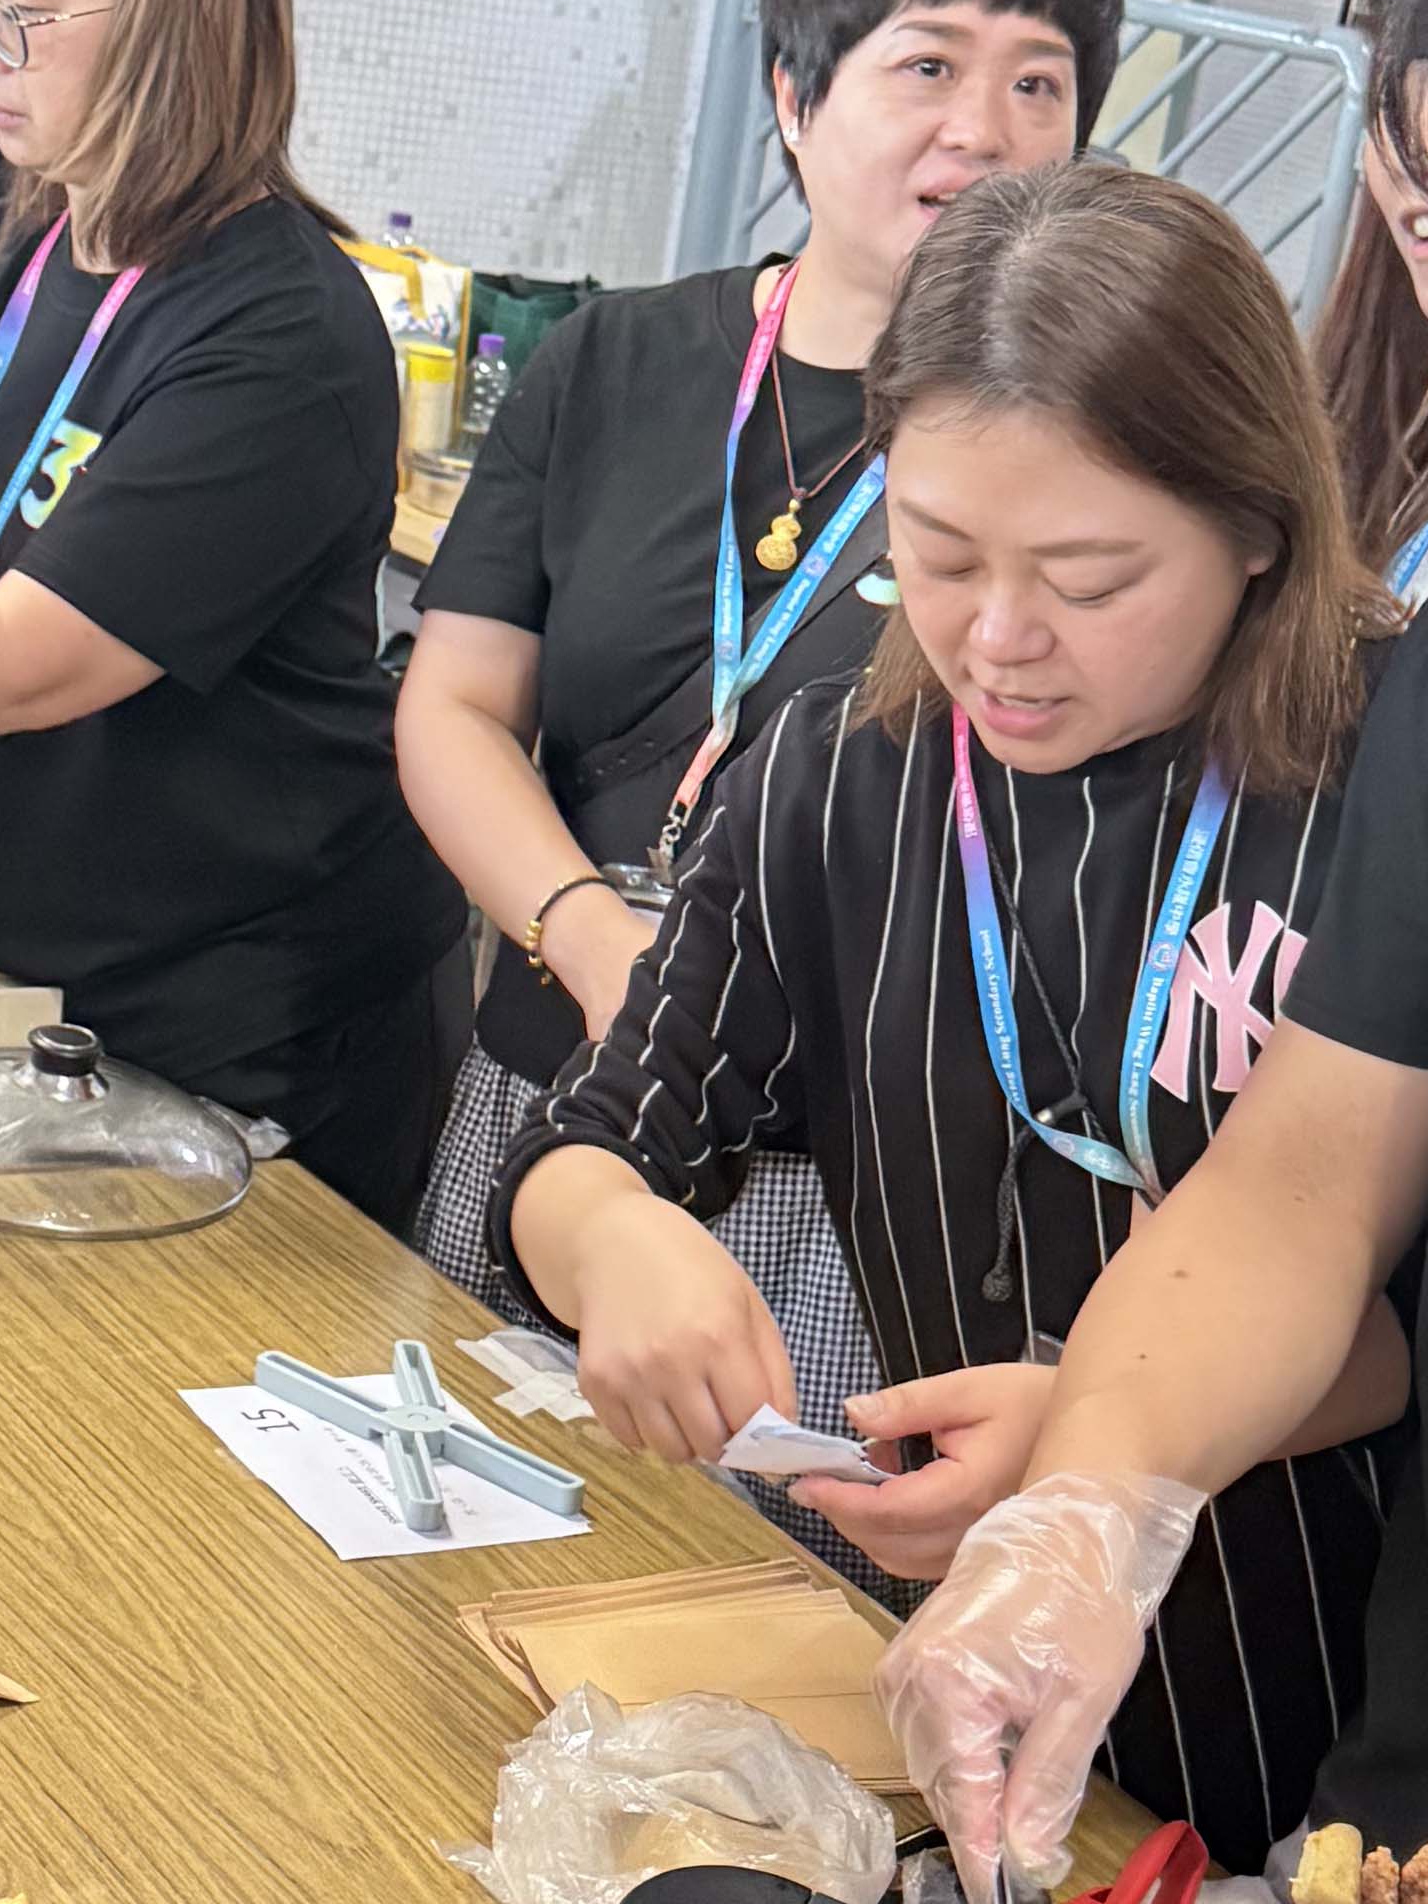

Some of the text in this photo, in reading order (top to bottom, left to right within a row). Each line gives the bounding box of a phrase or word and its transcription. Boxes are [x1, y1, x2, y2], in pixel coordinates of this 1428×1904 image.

[979, 928, 994, 971] School
[987, 974, 1007, 1035] Secondary
[240, 1408, 301, 1433] 15
